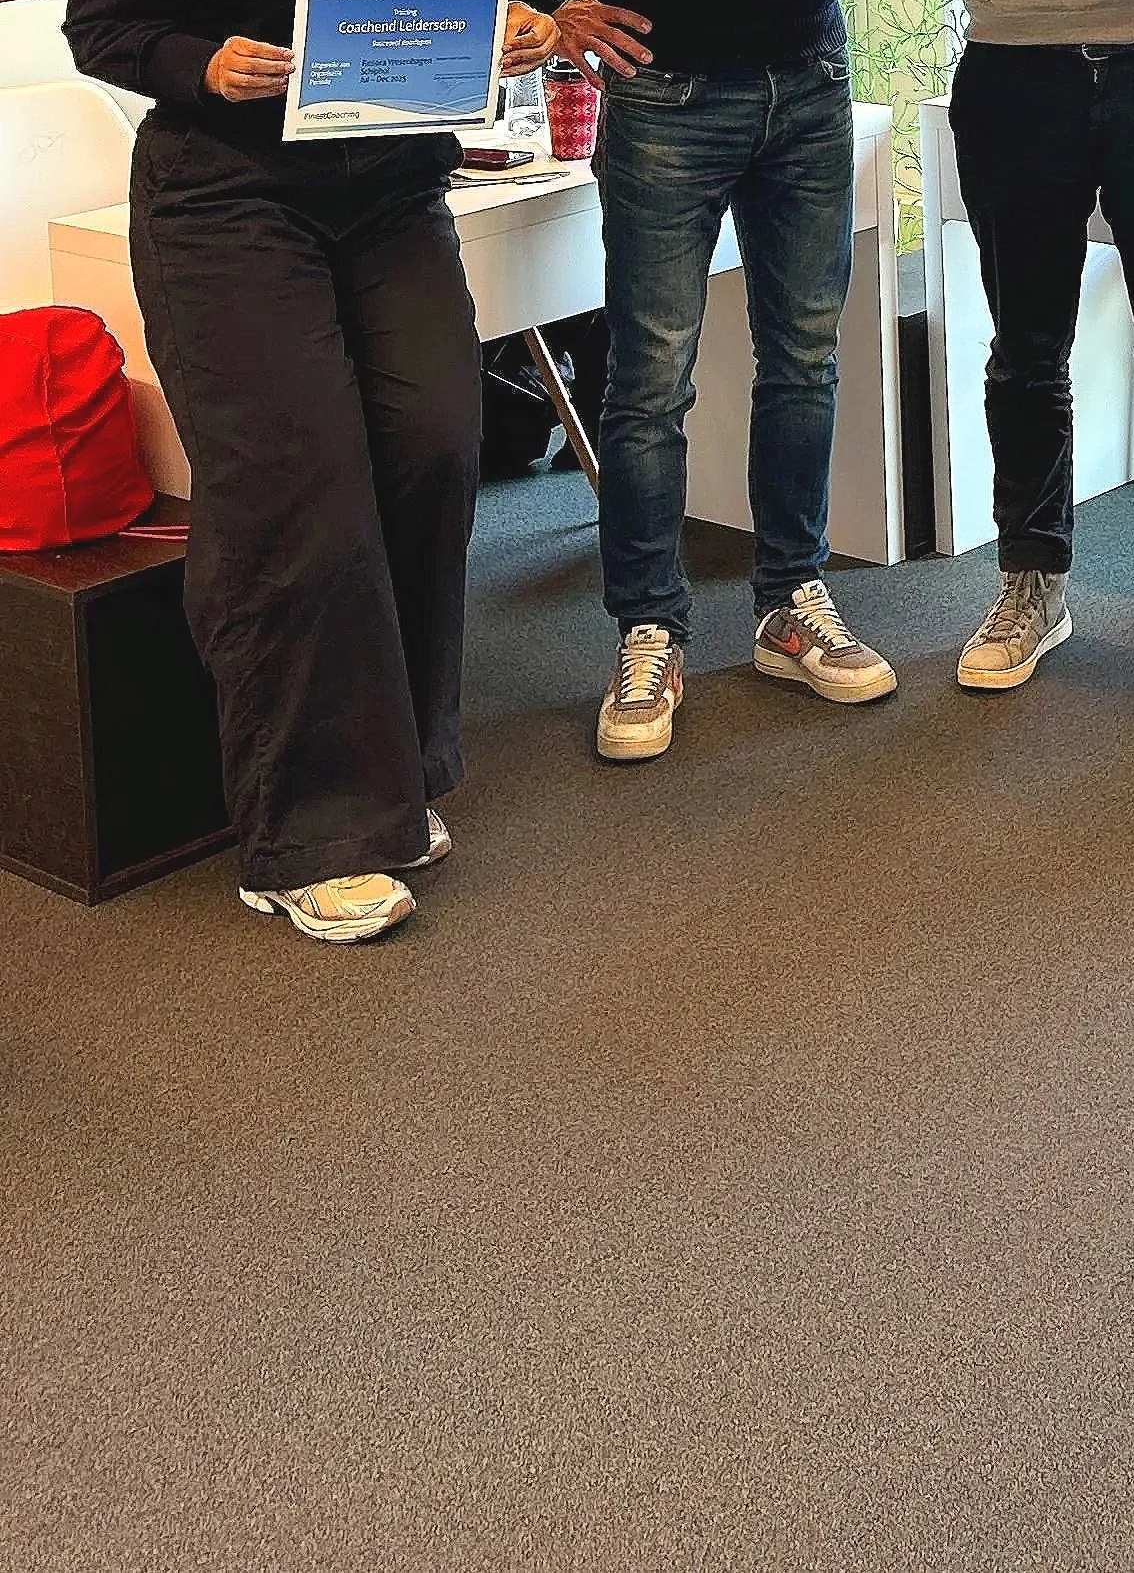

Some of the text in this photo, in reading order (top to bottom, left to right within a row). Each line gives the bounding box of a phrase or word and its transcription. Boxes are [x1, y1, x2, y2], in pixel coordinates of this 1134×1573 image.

[338, 19, 466, 34] Coachend Leiderschap
[376, 75, 390, 83] Dec
